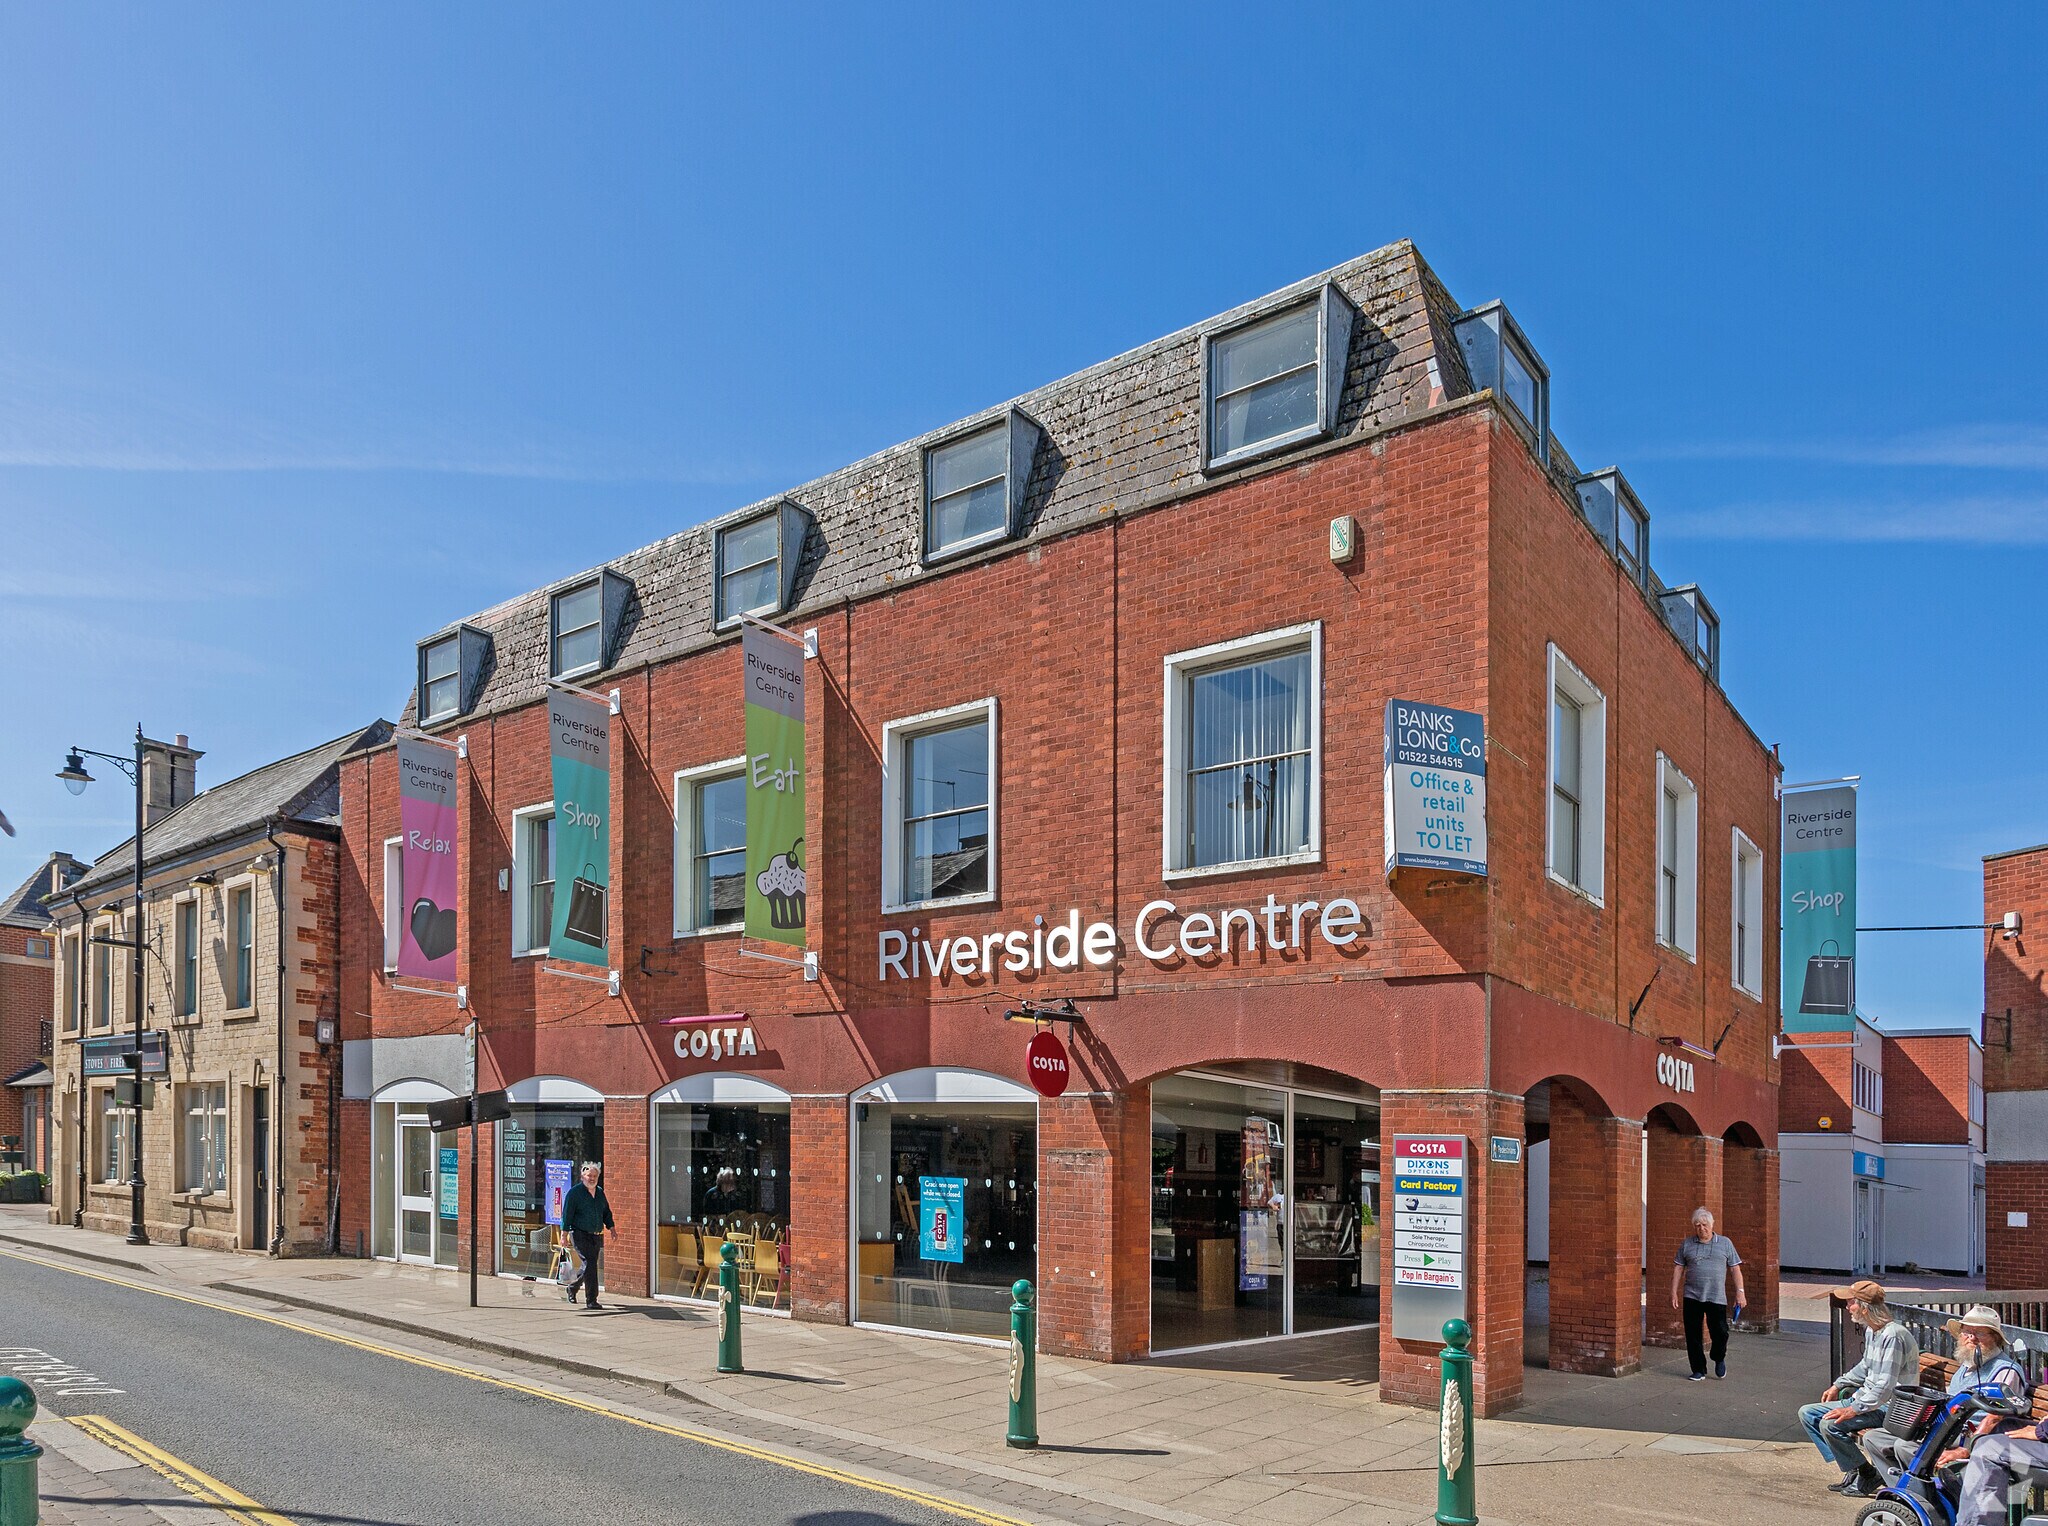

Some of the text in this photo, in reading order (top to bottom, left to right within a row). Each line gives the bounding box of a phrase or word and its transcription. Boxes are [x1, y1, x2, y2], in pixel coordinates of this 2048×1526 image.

[747, 653, 801, 685] Riverside
[755, 676, 795, 702] Centre
[553, 713, 606, 739] Riverside
[1397, 707, 1454, 733] BANKS
[561, 733, 600, 754] Centre
[1398, 727, 1481, 758] LONG&Co
[1399, 750, 1463, 768] 01522 544515
[402, 758, 454, 780] Riverside
[751, 753, 799, 793] Eat
[410, 775, 447, 793] Centre
[1410, 771, 1474, 795] Office &
[1423, 796, 1465, 813] retail
[562, 801, 601, 840] Shop
[1425, 815, 1465, 833] units
[1788, 809, 1852, 824] Riverside
[1416, 831, 1473, 853] TO LET
[1796, 827, 1843, 839] Centre
[409, 831, 451, 854] Relax
[1791, 889, 1844, 916] Shop
[878, 894, 1361, 981] Riverside Centre
[673, 1027, 757, 1061] COSTA
[84, 1058, 103, 1069] STOVES
[1032, 1056, 1066, 1072] COSTA
[1656, 1052, 1695, 1093] COSTA
[504, 1140, 526, 1152] COFFEE
[1409, 1143, 1447, 1155] COSTA
[504, 1167, 526, 1179] DRINKS
[1407, 1160, 1449, 1169] DIXONS
[1400, 1180, 1457, 1192] Card Factory
[441, 1204, 449, 1213] TO
[504, 1198, 526, 1210] TOASTED
[1407, 1240, 1434, 1248] Chiropody
[1404, 1254, 1452, 1266] Press Play
[1402, 1270, 1455, 1283] Pop In Bargain's
